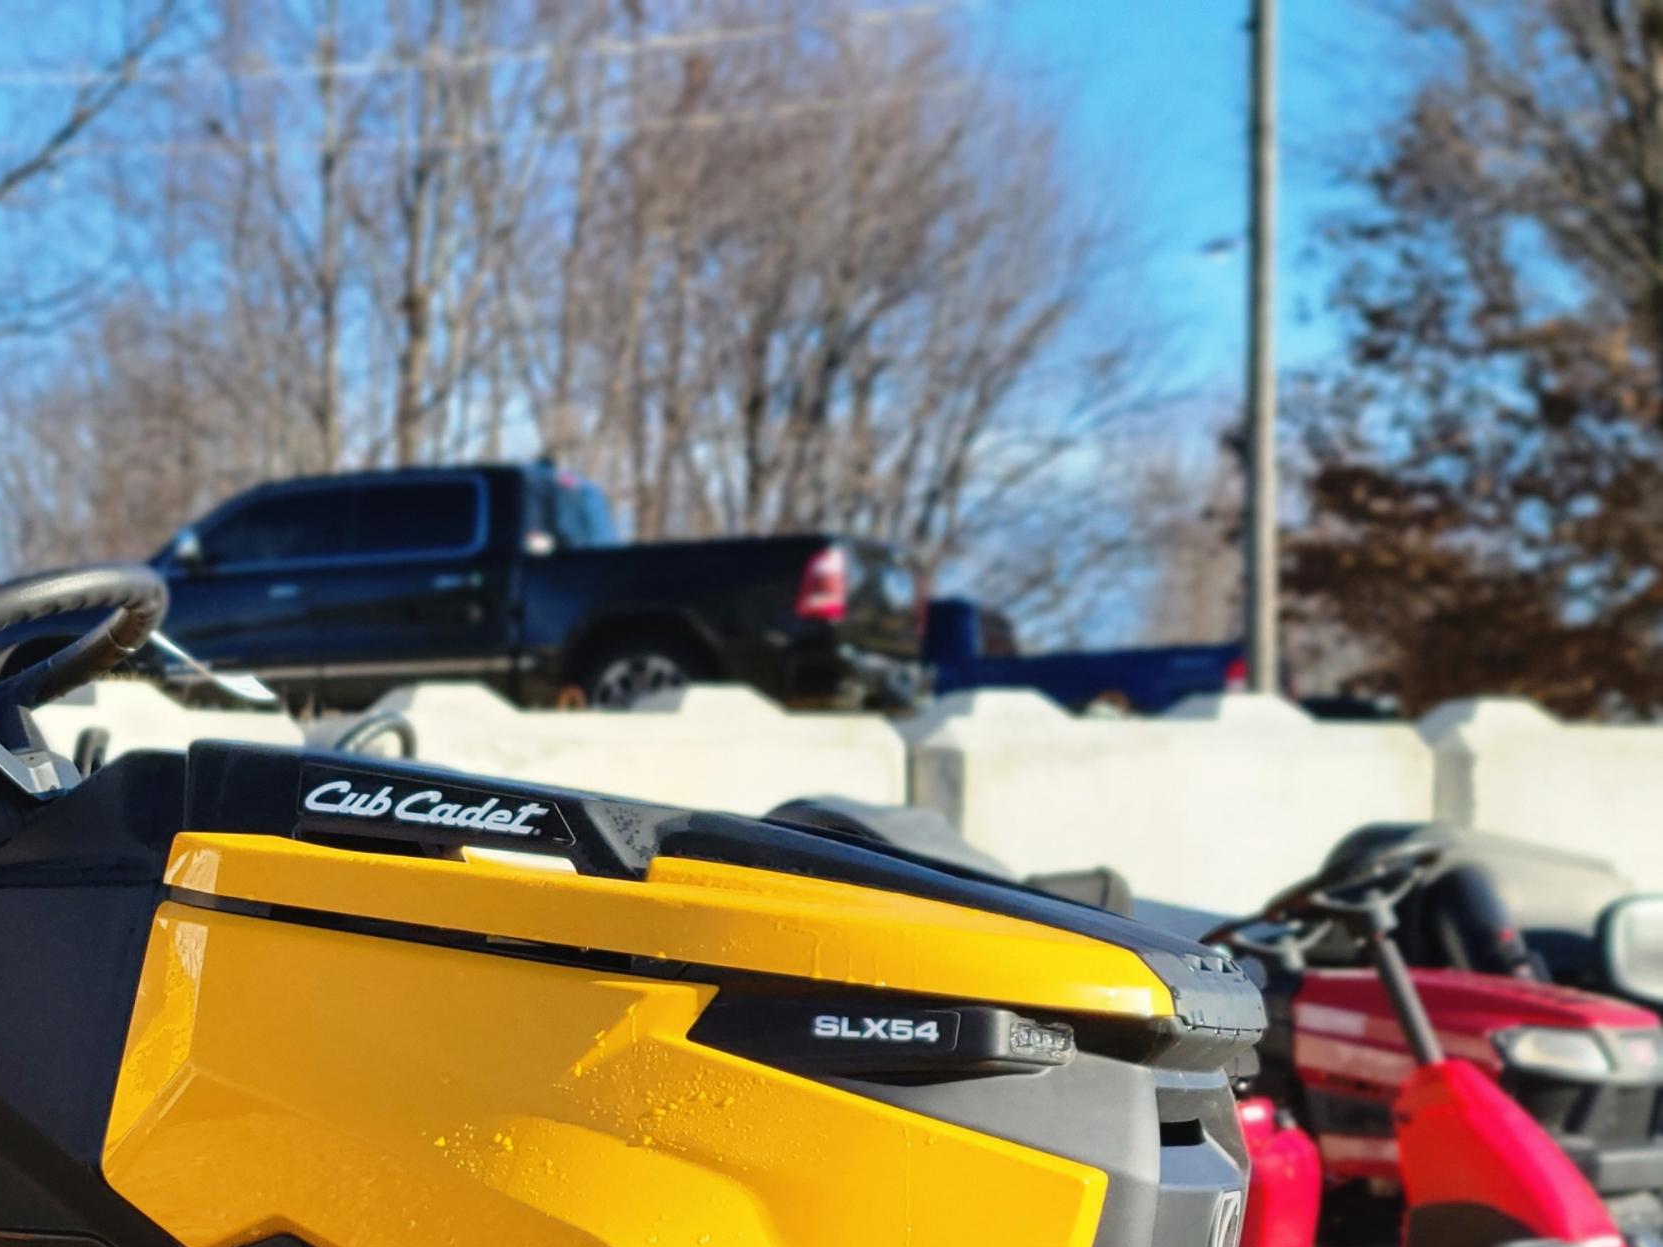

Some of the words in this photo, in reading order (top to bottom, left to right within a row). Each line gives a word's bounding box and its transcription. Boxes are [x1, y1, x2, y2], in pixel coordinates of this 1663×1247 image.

[304, 780, 394, 818] Cub
[394, 790, 549, 835] Cadet
[814, 1015, 940, 1042] SLX54
